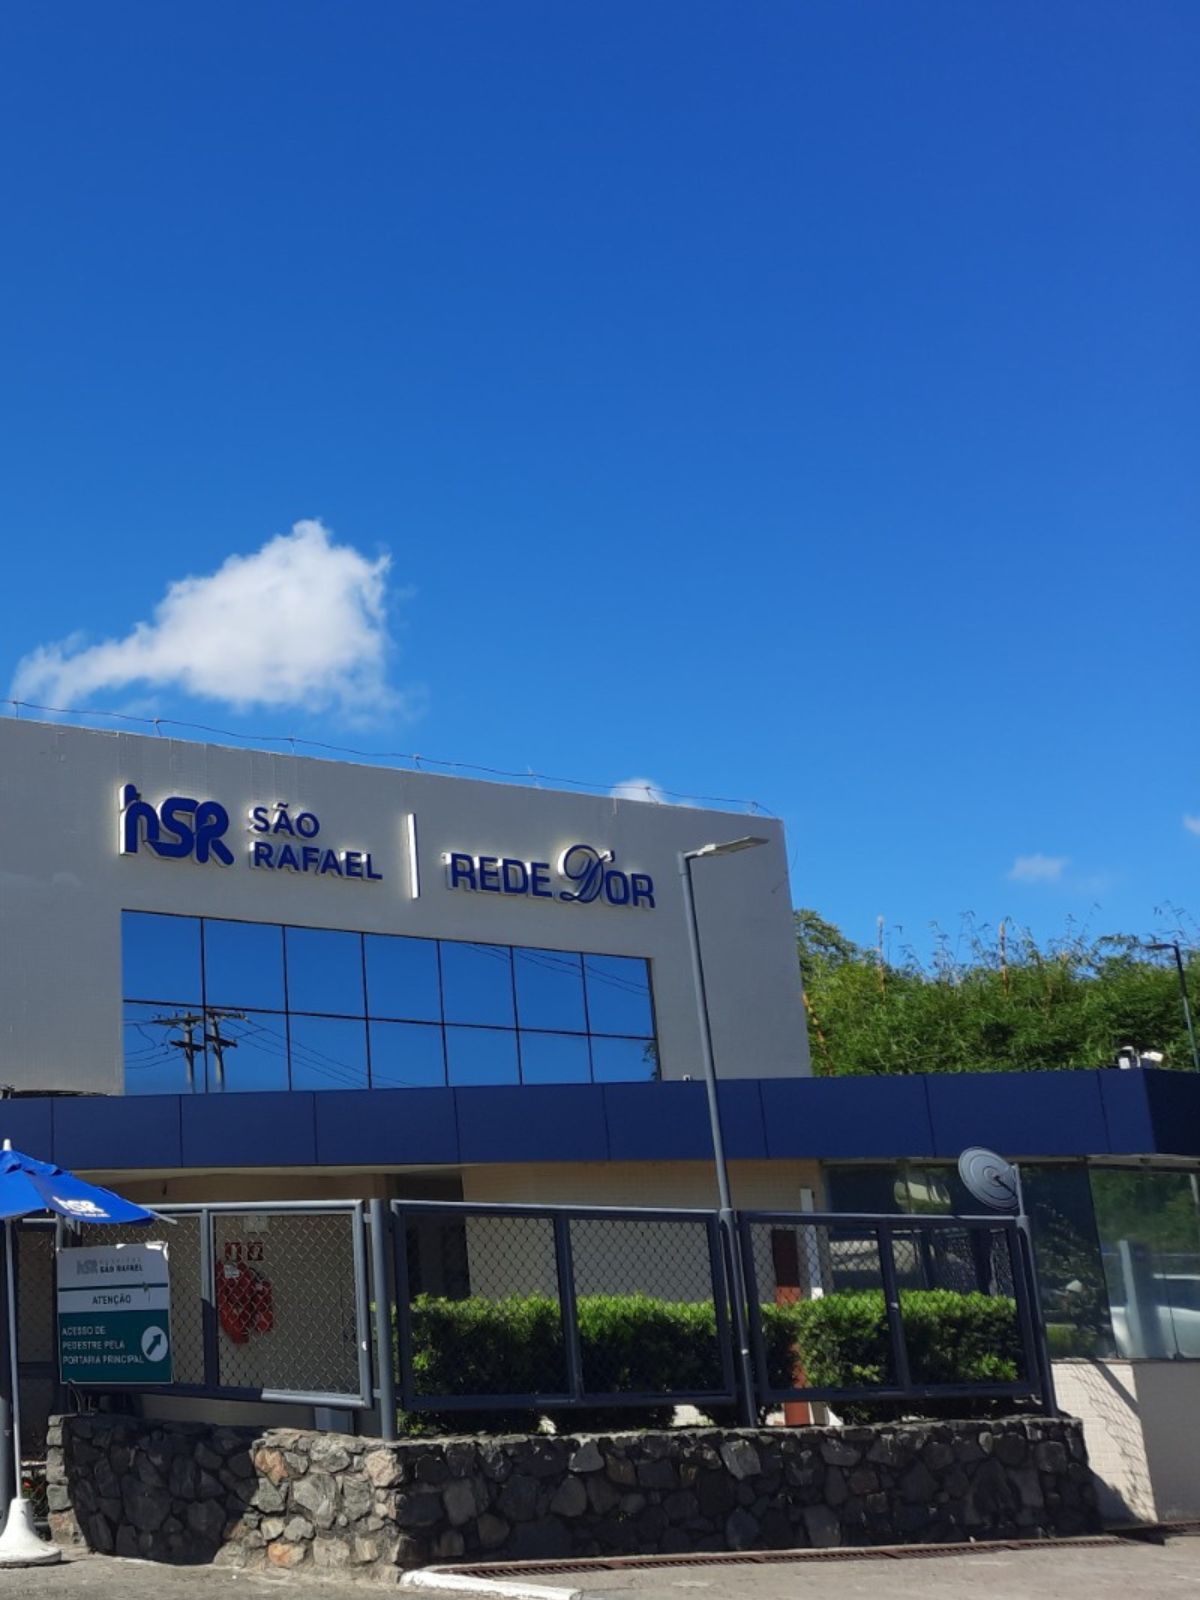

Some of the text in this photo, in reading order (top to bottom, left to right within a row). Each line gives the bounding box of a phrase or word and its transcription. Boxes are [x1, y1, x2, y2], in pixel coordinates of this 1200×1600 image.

[252, 802, 320, 838] SÃO
[252, 841, 384, 881] RAFAEL
[448, 852, 553, 898] REDE
[92, 1294, 131, 1306] ATENÇÃO
[62, 1326, 106, 1336] ACESSO DE
[62, 1340, 125, 1350] PEDESTRE PELA
[62, 1355, 144, 1365] PORTARIA PRINCIPAL
